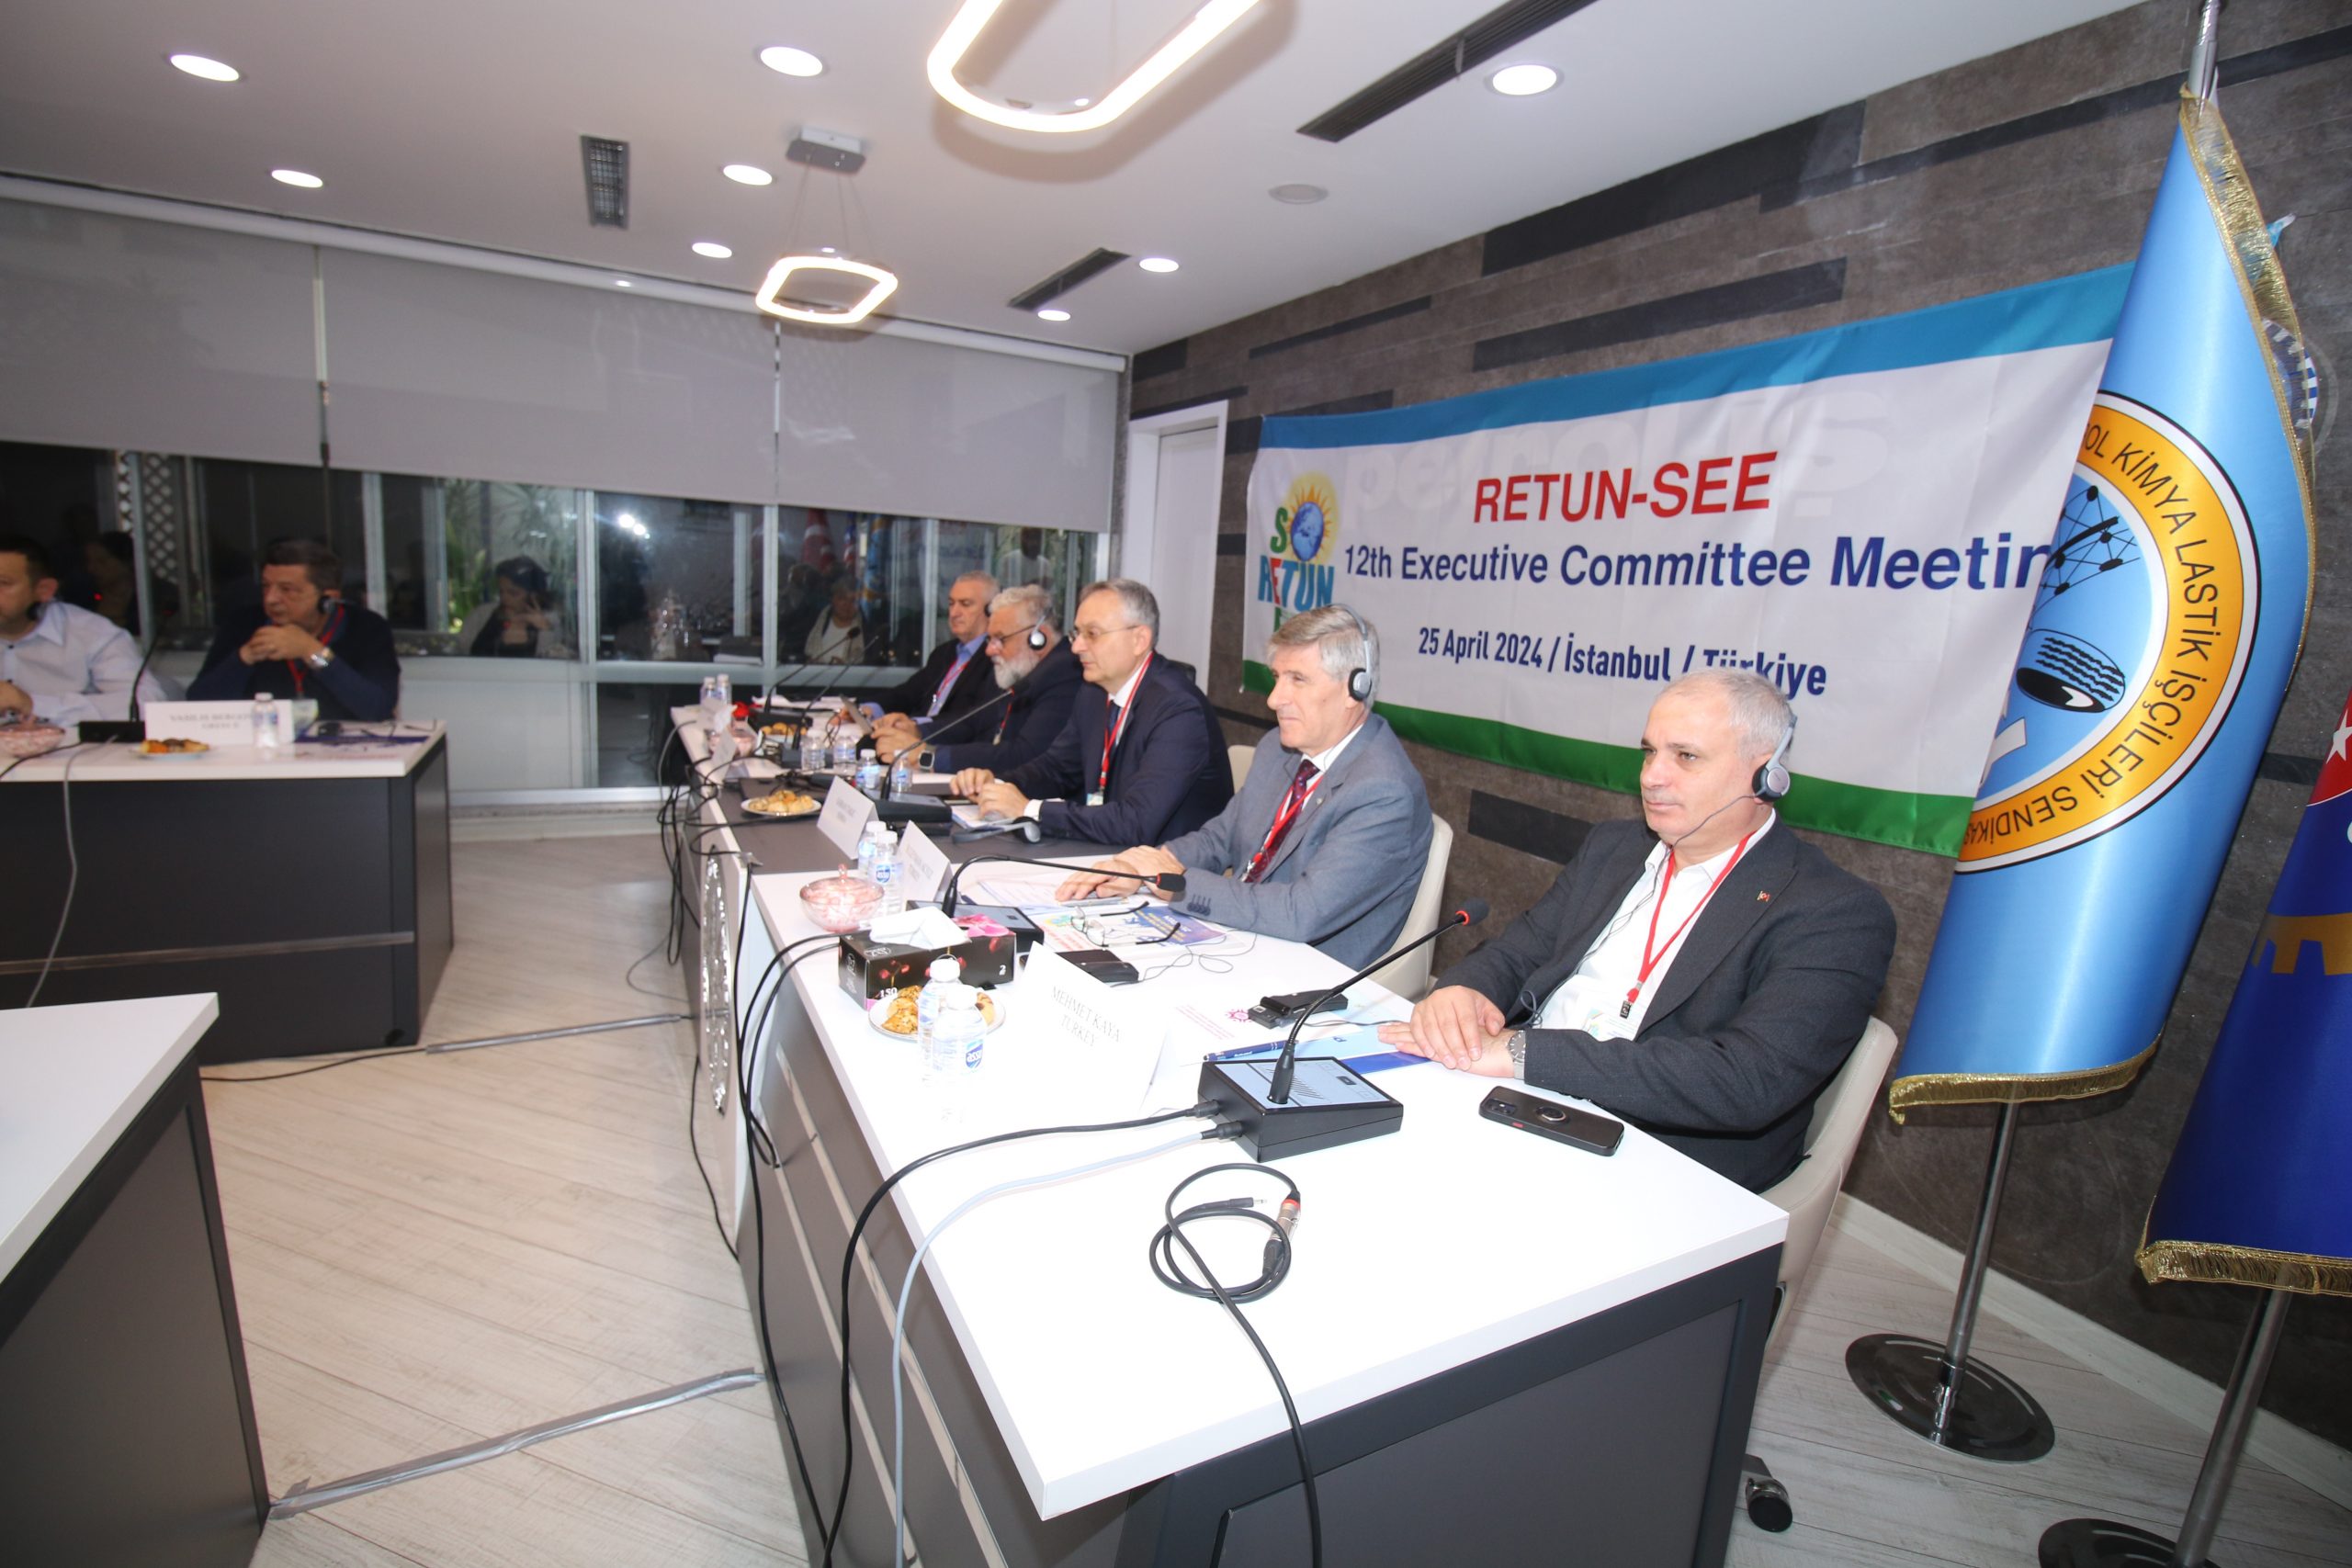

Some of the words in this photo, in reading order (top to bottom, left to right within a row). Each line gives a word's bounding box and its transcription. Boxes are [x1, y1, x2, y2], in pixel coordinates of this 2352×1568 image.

[2085, 423, 2109, 458] OL
[1474, 451, 1778, 524] RETUN-SEE
[2111, 442, 2197, 535] KİMYA
[1258, 555, 1335, 612] RETUN
[1344, 544, 1392, 579] 12th
[1401, 544, 1549, 582] Executive
[1561, 540, 1810, 587] Committee
[1830, 532, 2052, 590] Meetin
[2175, 538, 2222, 661] LASTİK
[1418, 626, 1441, 656] 25
[1442, 629, 1489, 663] April
[1494, 632, 1544, 668] 2024
[1546, 636, 1562, 672] /
[1564, 633, 1671, 682] İstanbul
[1702, 649, 1827, 700] Tkiye
[2080, 669, 2207, 798] İŞÇİLERİ
[1051, 985, 1094, 1022] MEHMET
